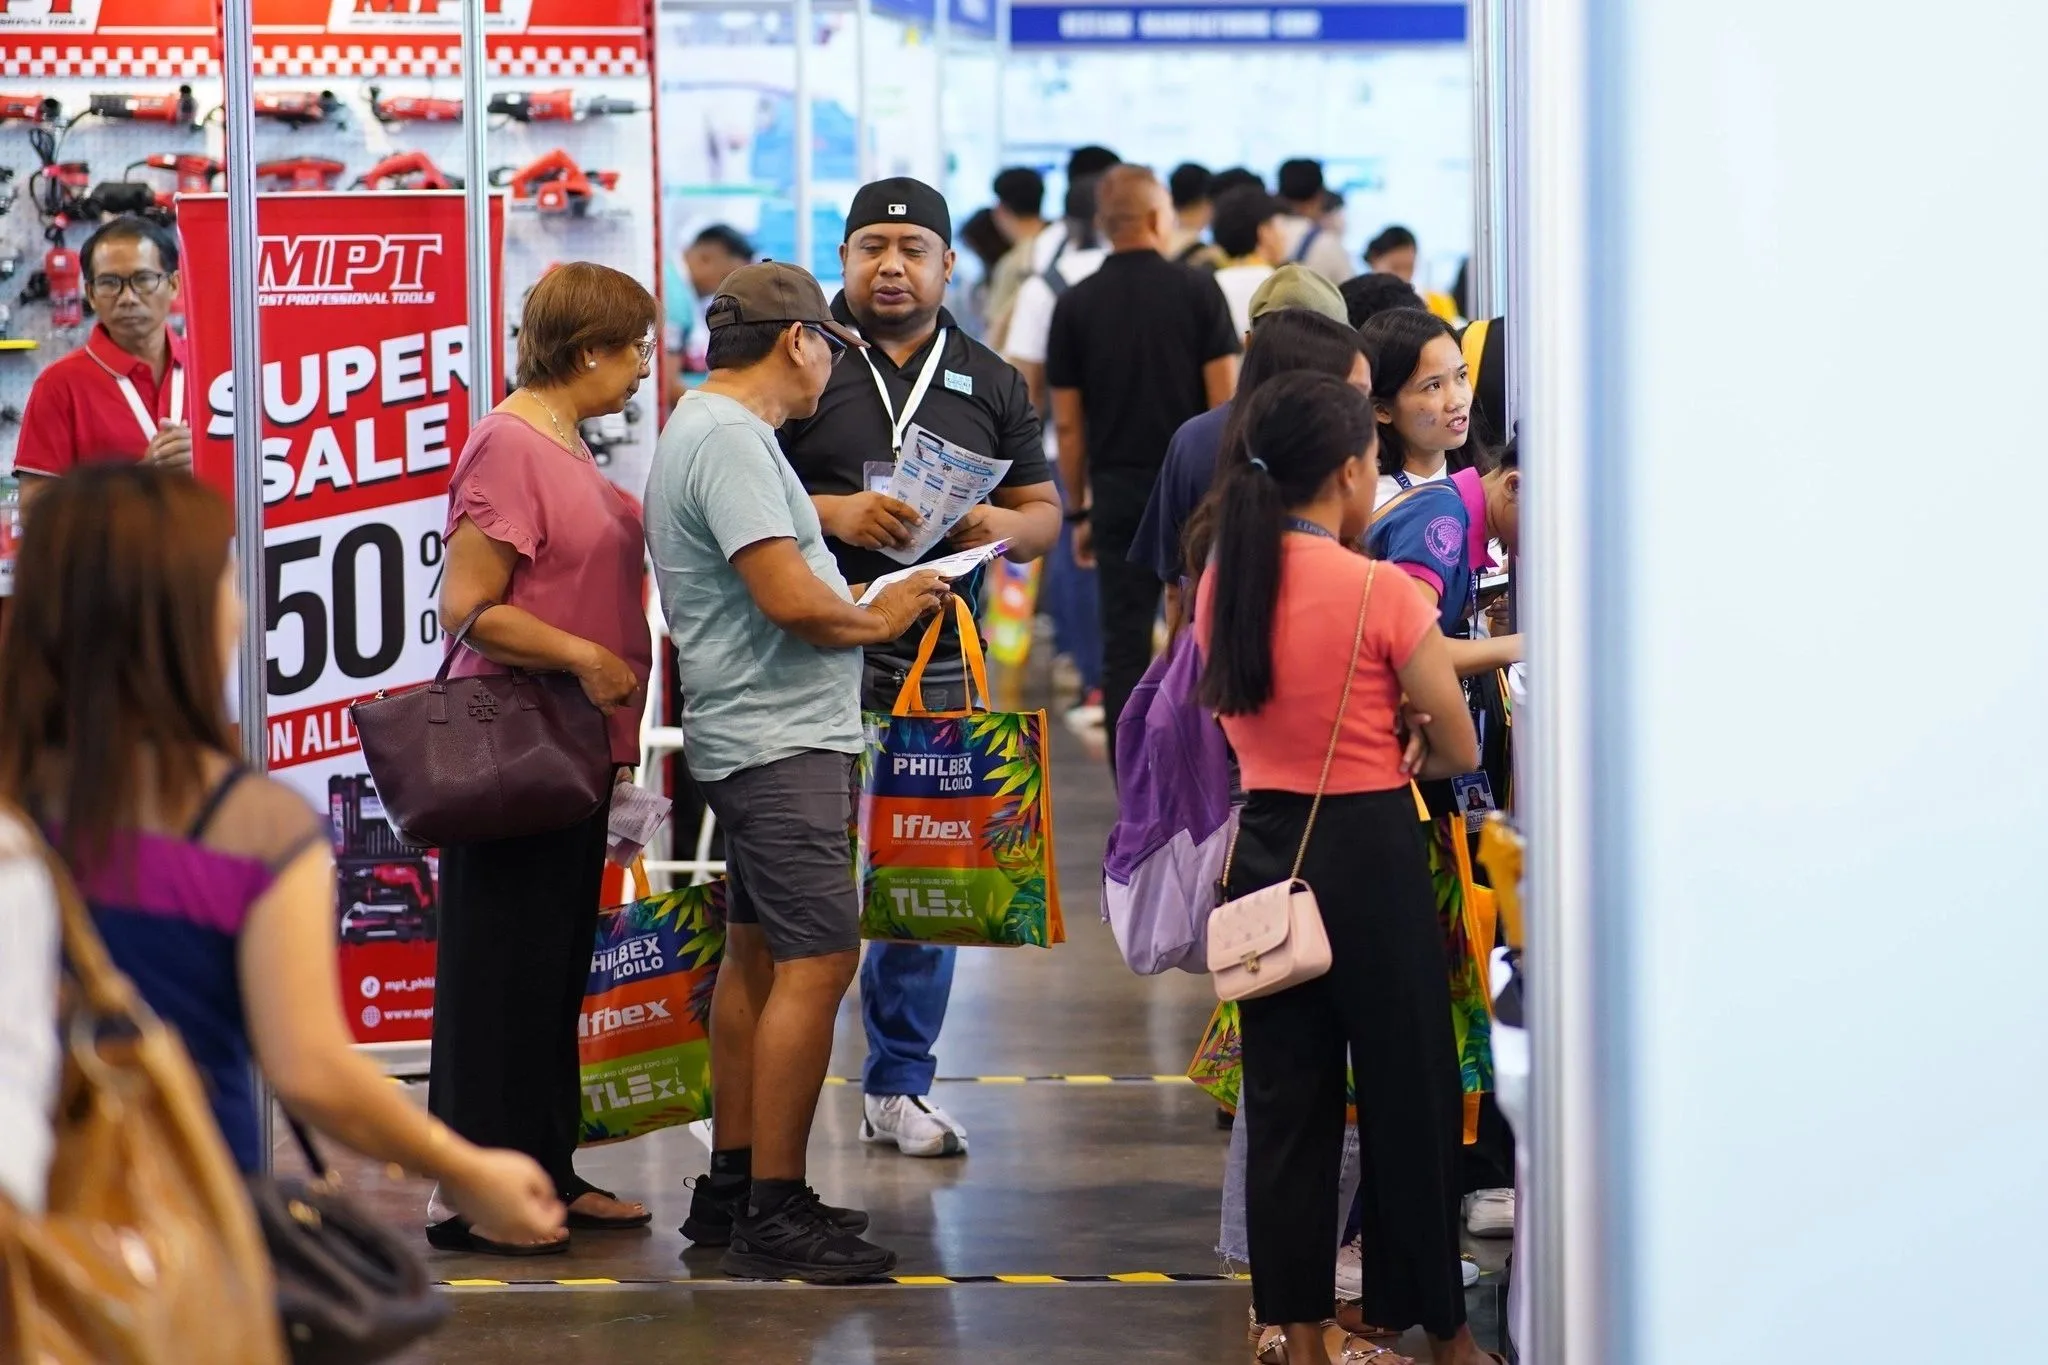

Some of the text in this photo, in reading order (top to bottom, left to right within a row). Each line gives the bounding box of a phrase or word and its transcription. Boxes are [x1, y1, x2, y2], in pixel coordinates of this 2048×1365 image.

[257, 233, 442, 292] MPT
[257, 291, 436, 307] OST PROFESSIONAL TOOLS
[206, 324, 470, 438] SUPER
[262, 402, 451, 505] SALE
[264, 522, 406, 697] 50
[267, 706, 358, 763] N ALL
[893, 757, 973, 776] PHILBEX
[940, 776, 973, 791] ILOILO
[892, 813, 973, 839] Ifbex
[590, 936, 662, 974] HILBEX
[613, 955, 664, 981] ILOILO
[578, 998, 671, 1037] Ifbex
